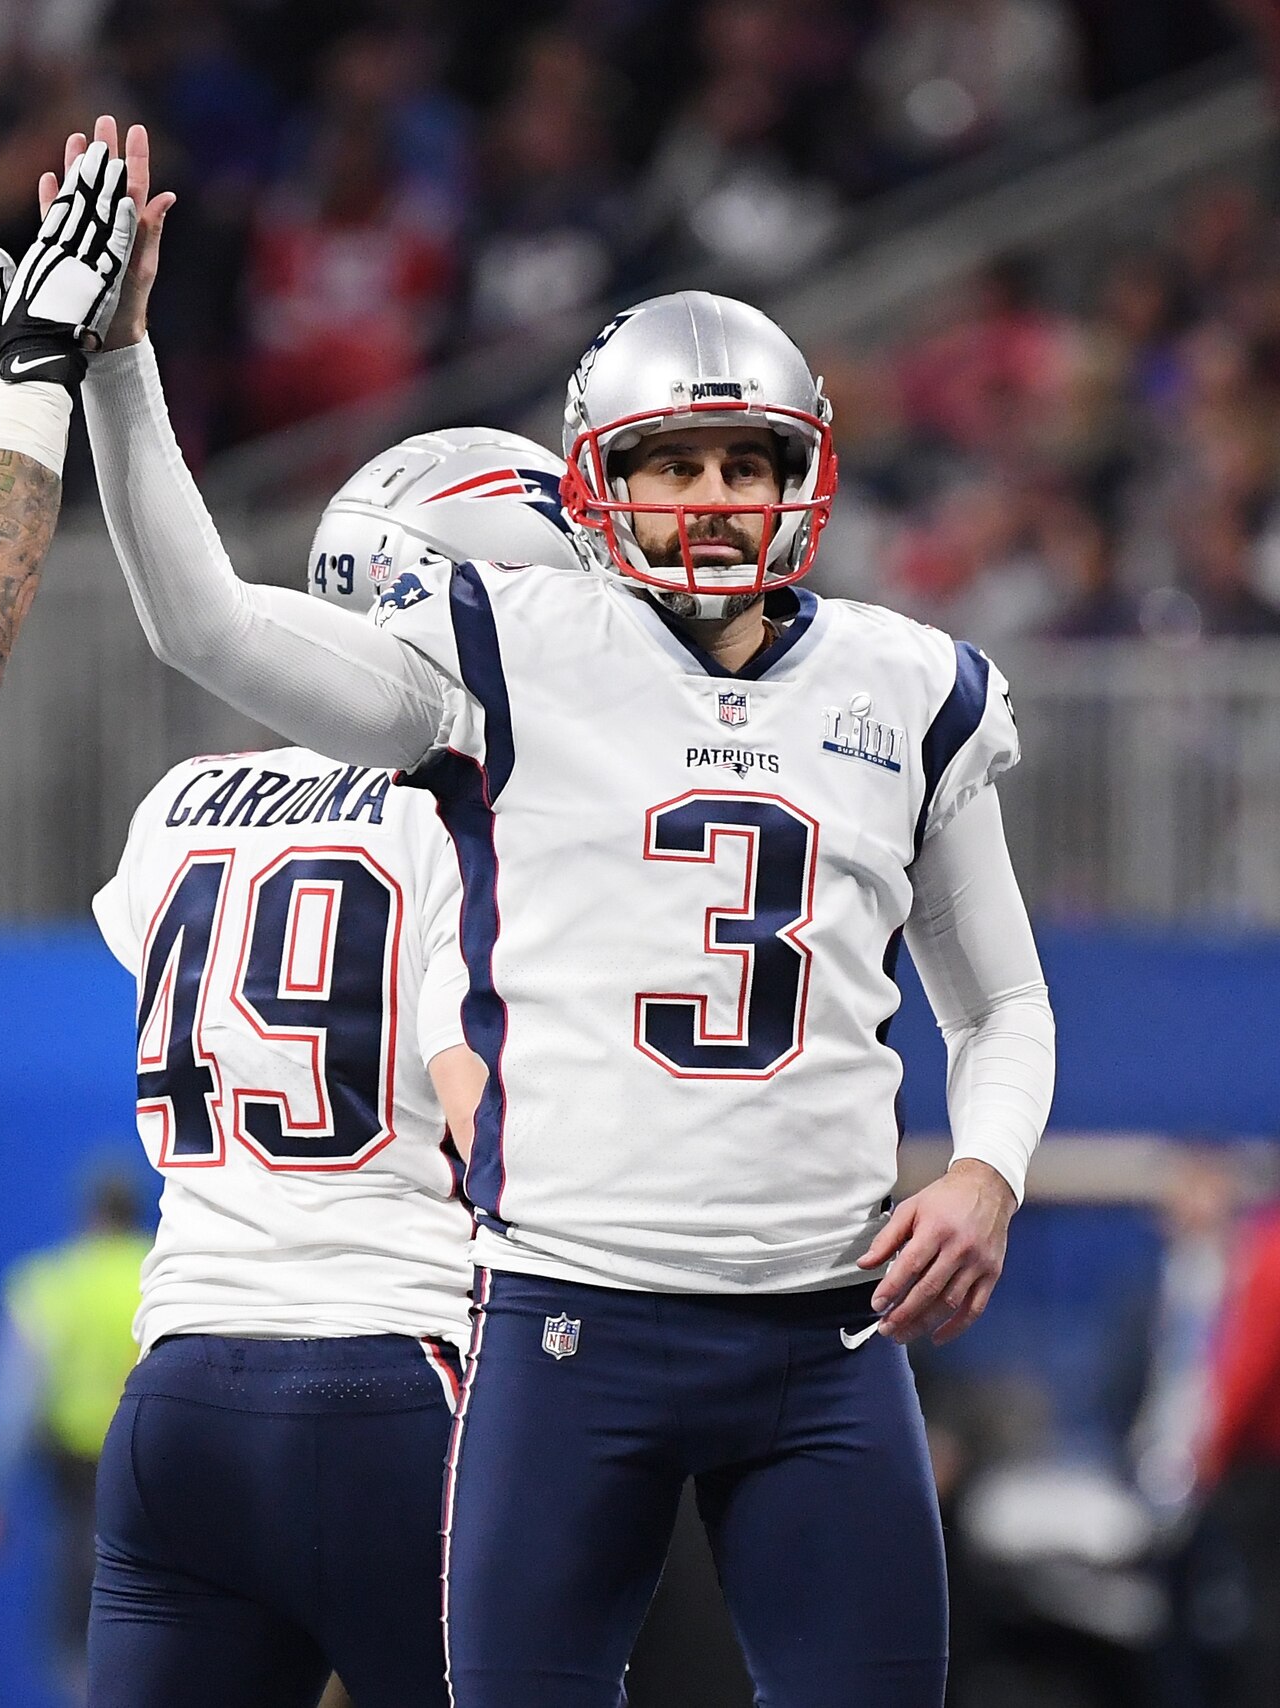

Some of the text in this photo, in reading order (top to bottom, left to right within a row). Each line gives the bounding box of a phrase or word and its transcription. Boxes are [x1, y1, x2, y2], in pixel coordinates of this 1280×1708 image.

[692, 383, 742, 401] PATRIOTS
[314, 553, 355, 594] 49
[686, 748, 779, 773] PATRIOTS
[837, 746, 888, 766] SUPER BOWL
[166, 756, 392, 828] CARDONA
[634, 789, 820, 1080] 3
[136, 846, 403, 1171] 49
